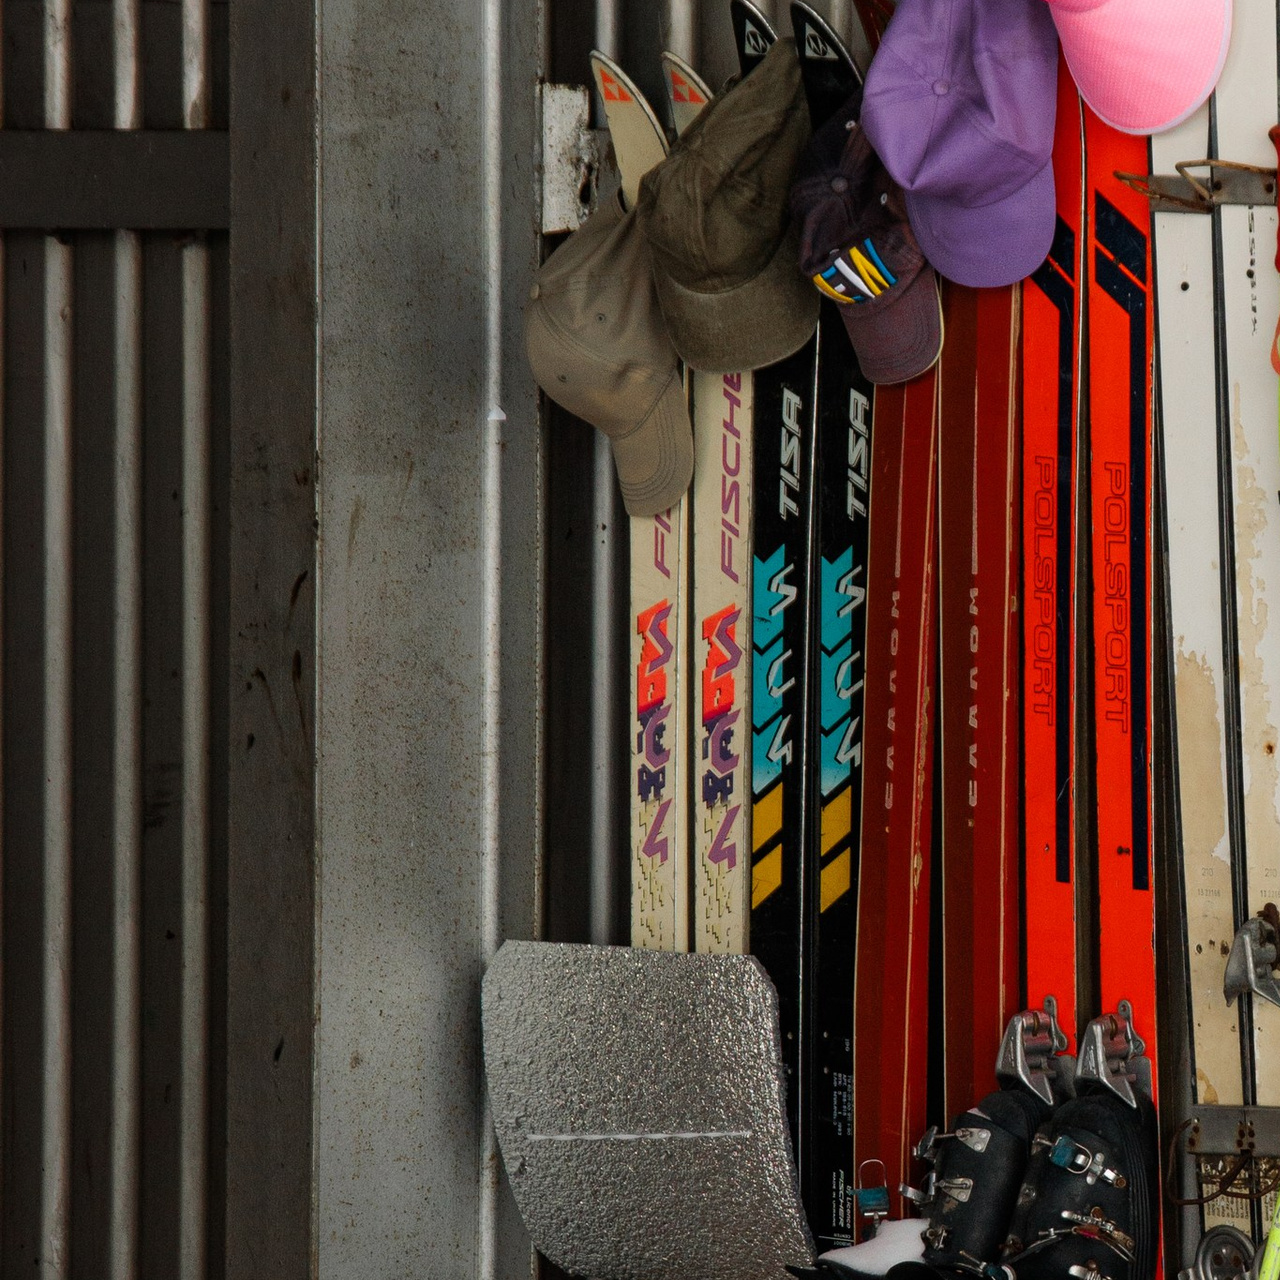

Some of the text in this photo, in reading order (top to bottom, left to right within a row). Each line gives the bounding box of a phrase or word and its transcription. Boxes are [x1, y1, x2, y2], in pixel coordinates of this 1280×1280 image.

[780, 386, 803, 521] TISA
[847, 387, 870, 521] TISA
[1034, 455, 1055, 726] POLSPORT
[1105, 461, 1128, 734] POLSPORT
